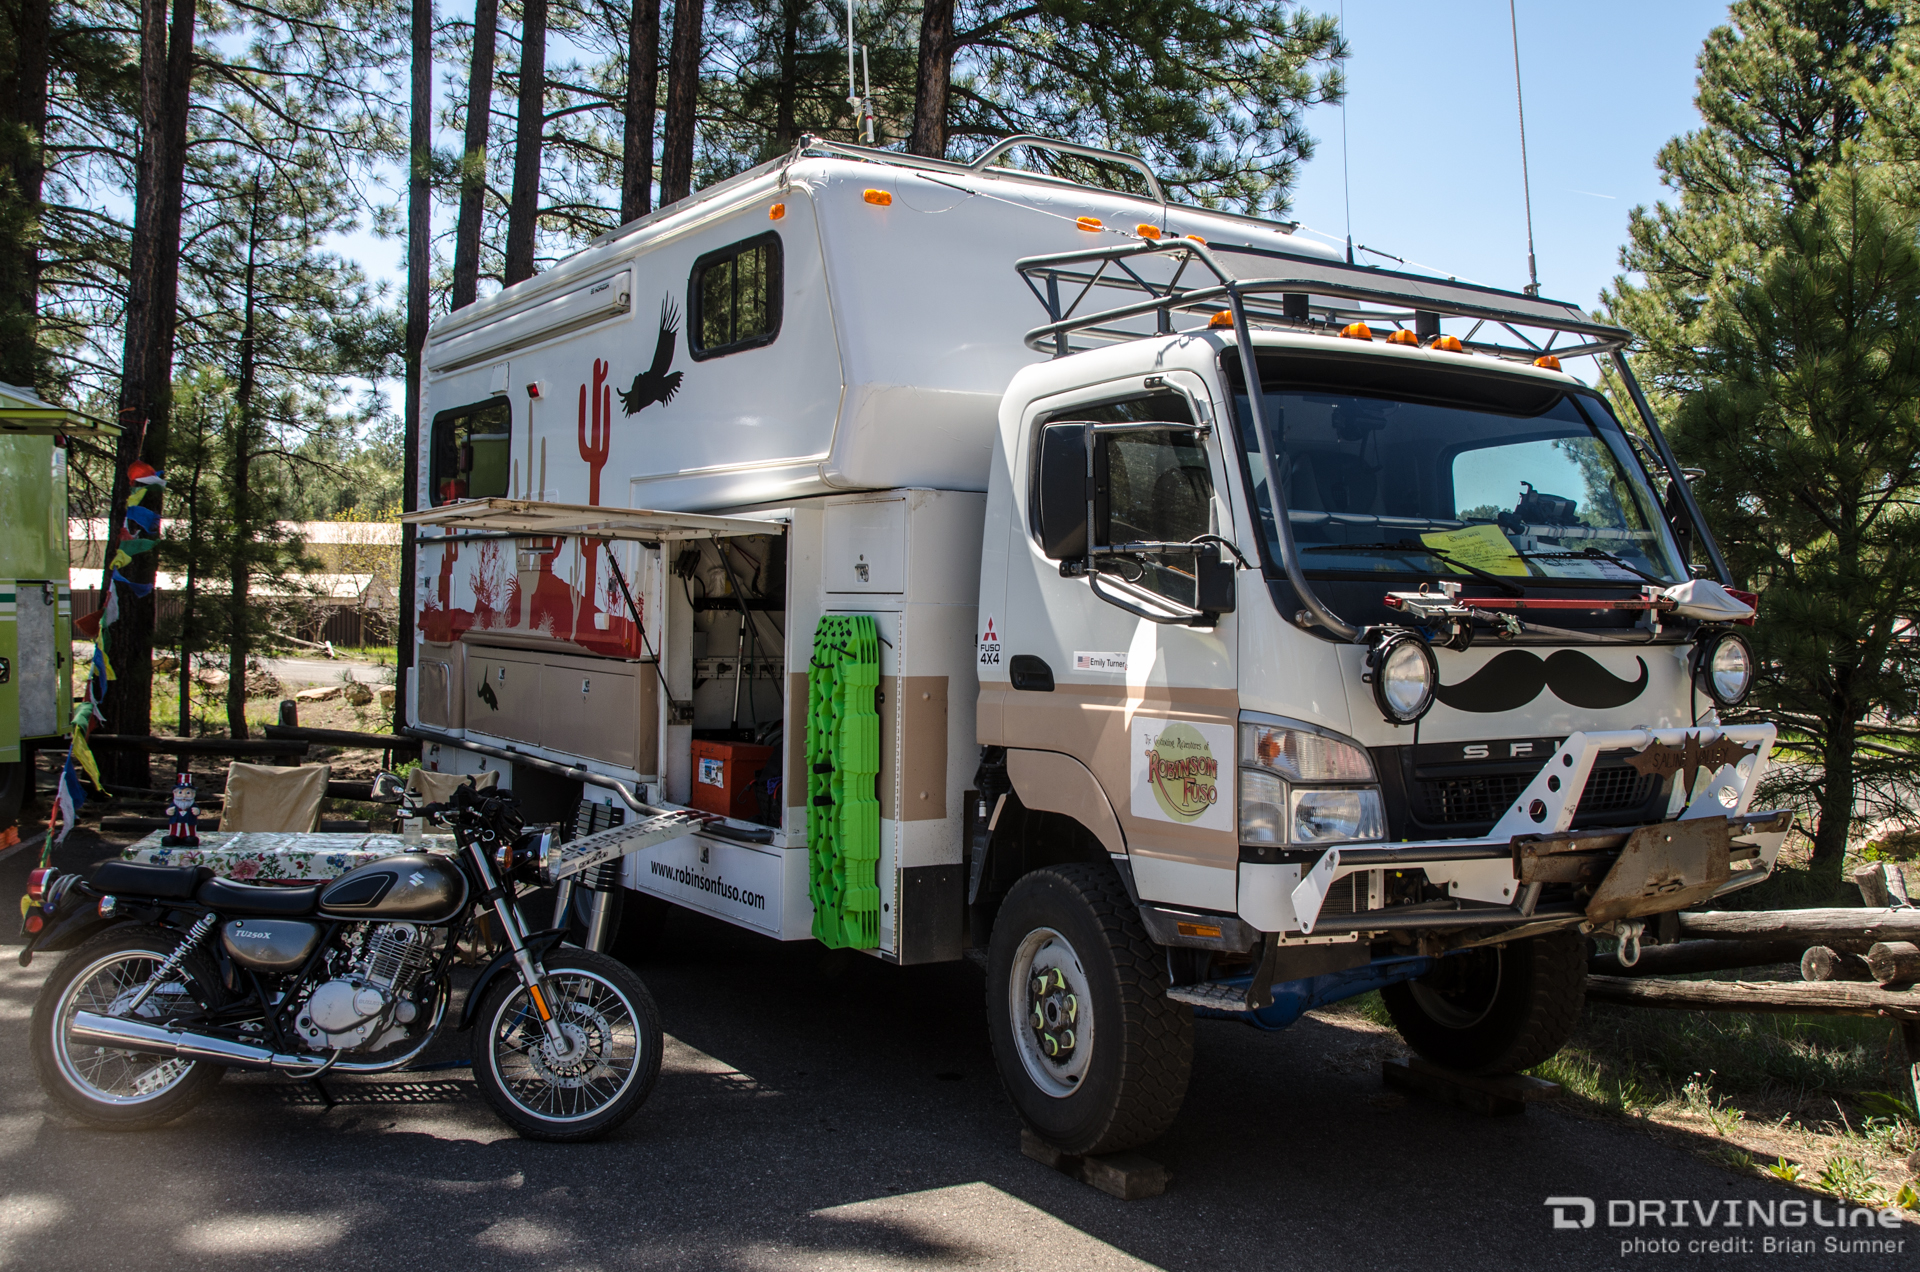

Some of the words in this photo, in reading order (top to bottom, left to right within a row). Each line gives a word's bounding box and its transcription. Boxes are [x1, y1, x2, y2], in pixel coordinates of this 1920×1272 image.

[980, 643, 1001, 652] FUSO
[980, 652, 1000, 665] 4X4
[1090, 657, 1105, 668] Emily
[1182, 776, 1217, 807] FUSO
[650, 860, 765, 911] www.robinsonfuso.com
[235, 930, 272, 940] TU250X
